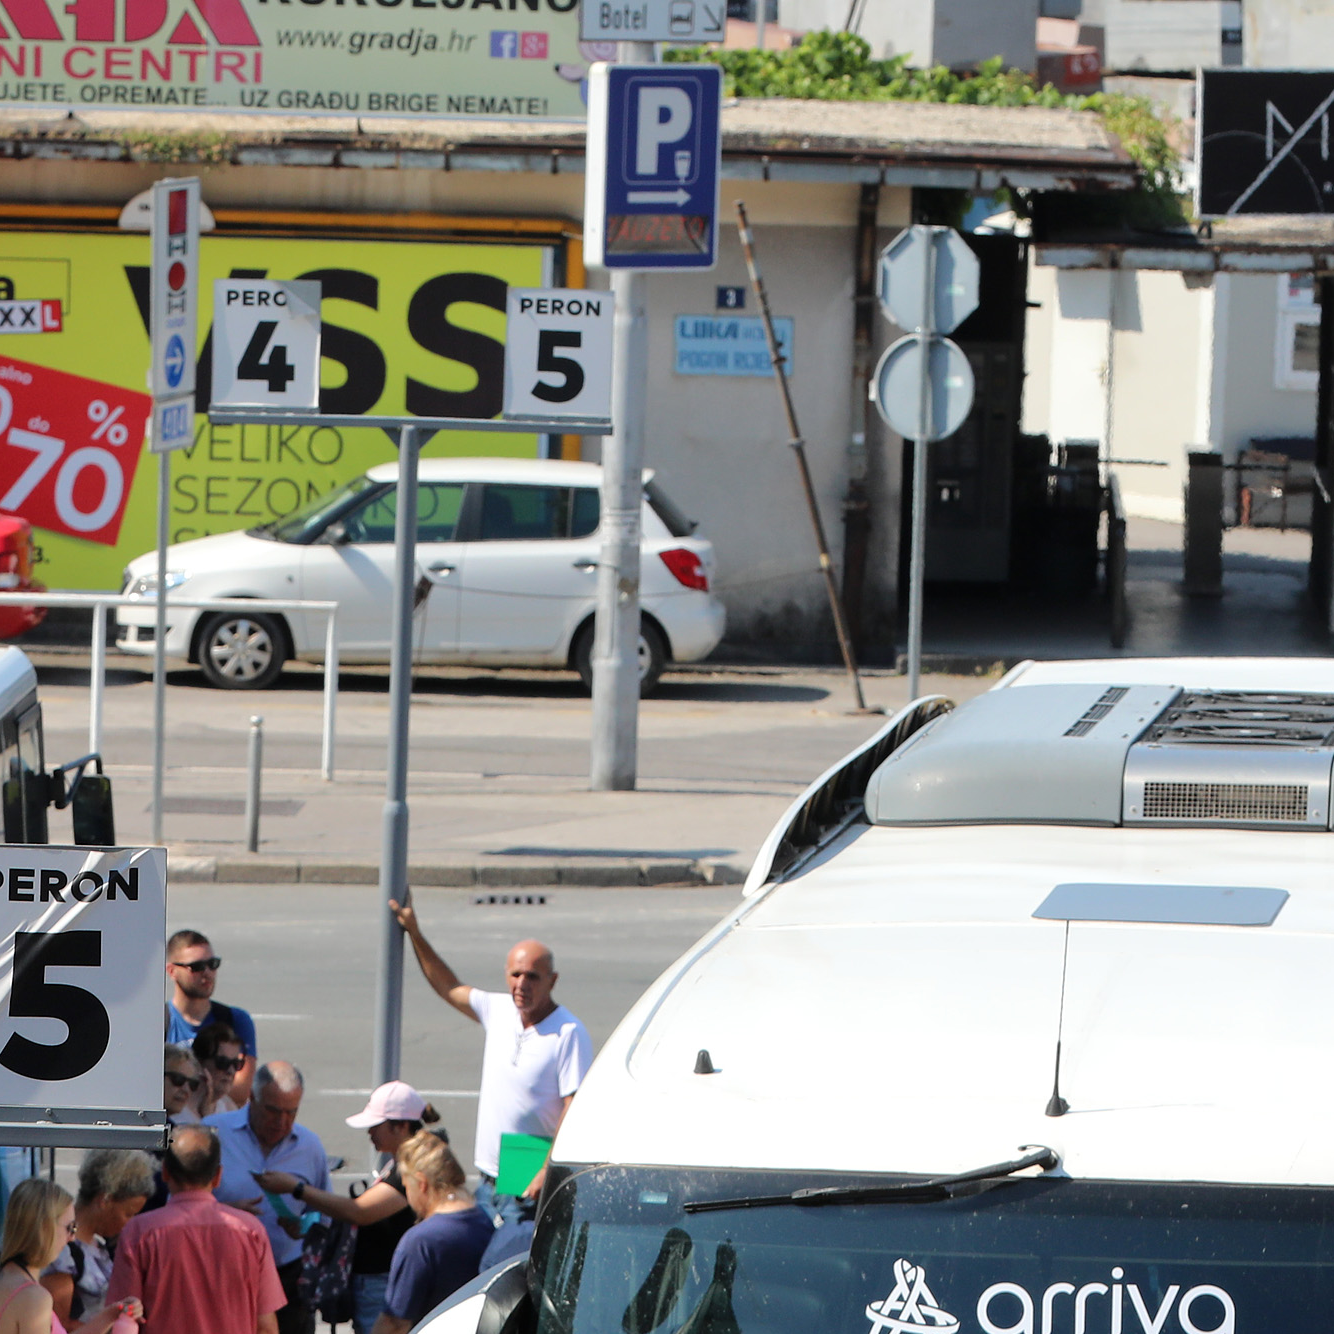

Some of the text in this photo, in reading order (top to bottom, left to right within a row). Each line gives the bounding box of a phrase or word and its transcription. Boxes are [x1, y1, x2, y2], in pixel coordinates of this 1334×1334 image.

[599, 2, 648, 30] Botel
[276, 29, 477, 56] www.gradja.hr
[62, 46, 263, 83] CENTRI
[239, 89, 270, 108] UZ
[277, 90, 360, 111] GRAĐU
[367, 93, 438, 113] BRIGE
[446, 95, 548, 115] NEMATE!
[635, 87, 693, 176] P
[226, 290, 287, 308] PERO
[519, 297, 602, 318] PERON
[678, 321, 740, 339] LUKA
[236, 320, 295, 393] 4
[530, 329, 586, 404] 5
[27, 416, 50, 434] do
[86, 399, 130, 448] %
